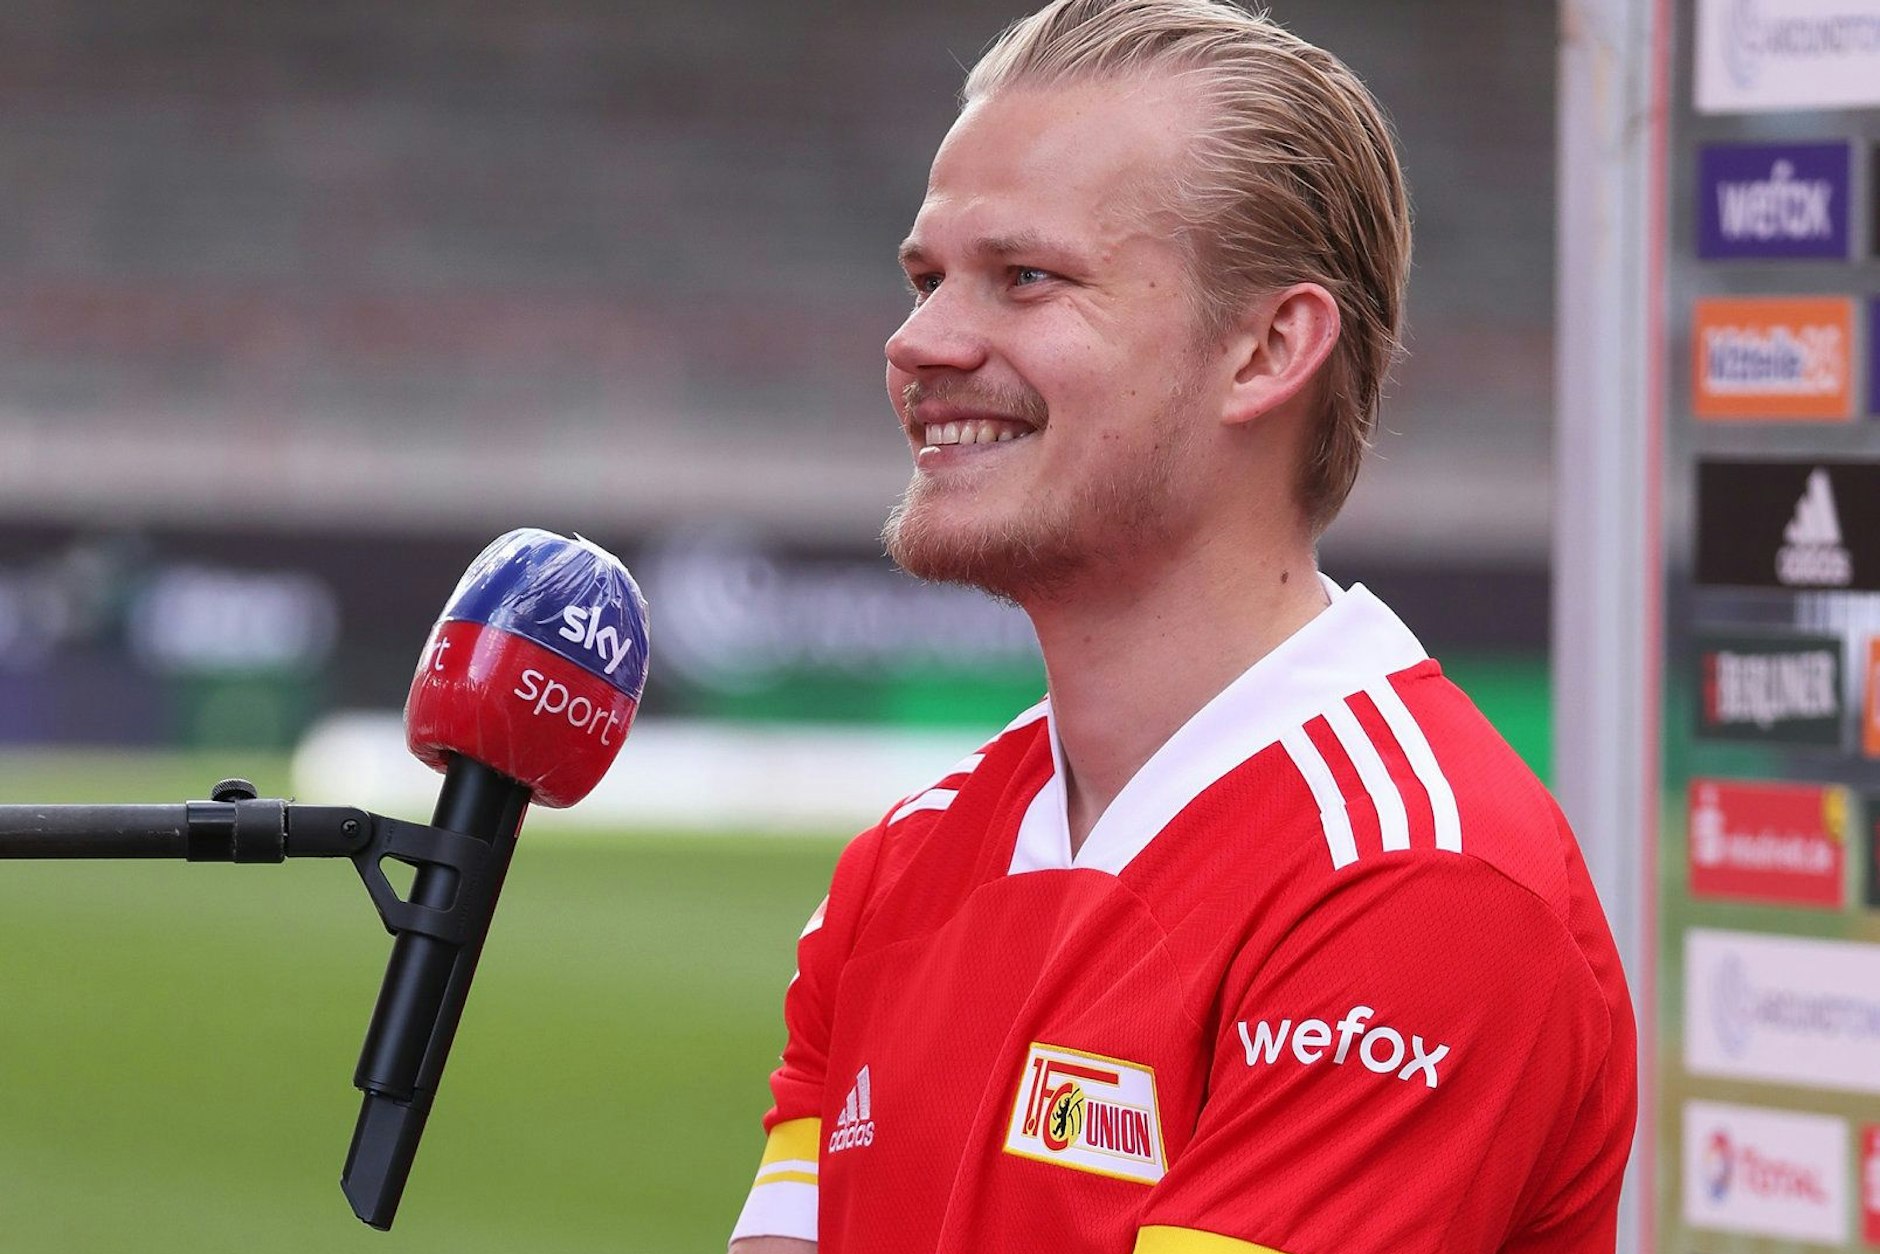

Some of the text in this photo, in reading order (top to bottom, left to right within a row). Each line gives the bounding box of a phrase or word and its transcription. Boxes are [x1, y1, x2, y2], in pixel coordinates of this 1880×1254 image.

[1716, 159, 1834, 240] wefox
[558, 605, 632, 675] sky
[513, 669, 620, 746] sport
[1237, 1005, 1451, 1089] wefox
[828, 1119, 875, 1153] adidas
[1085, 1100, 1152, 1158] UNION
